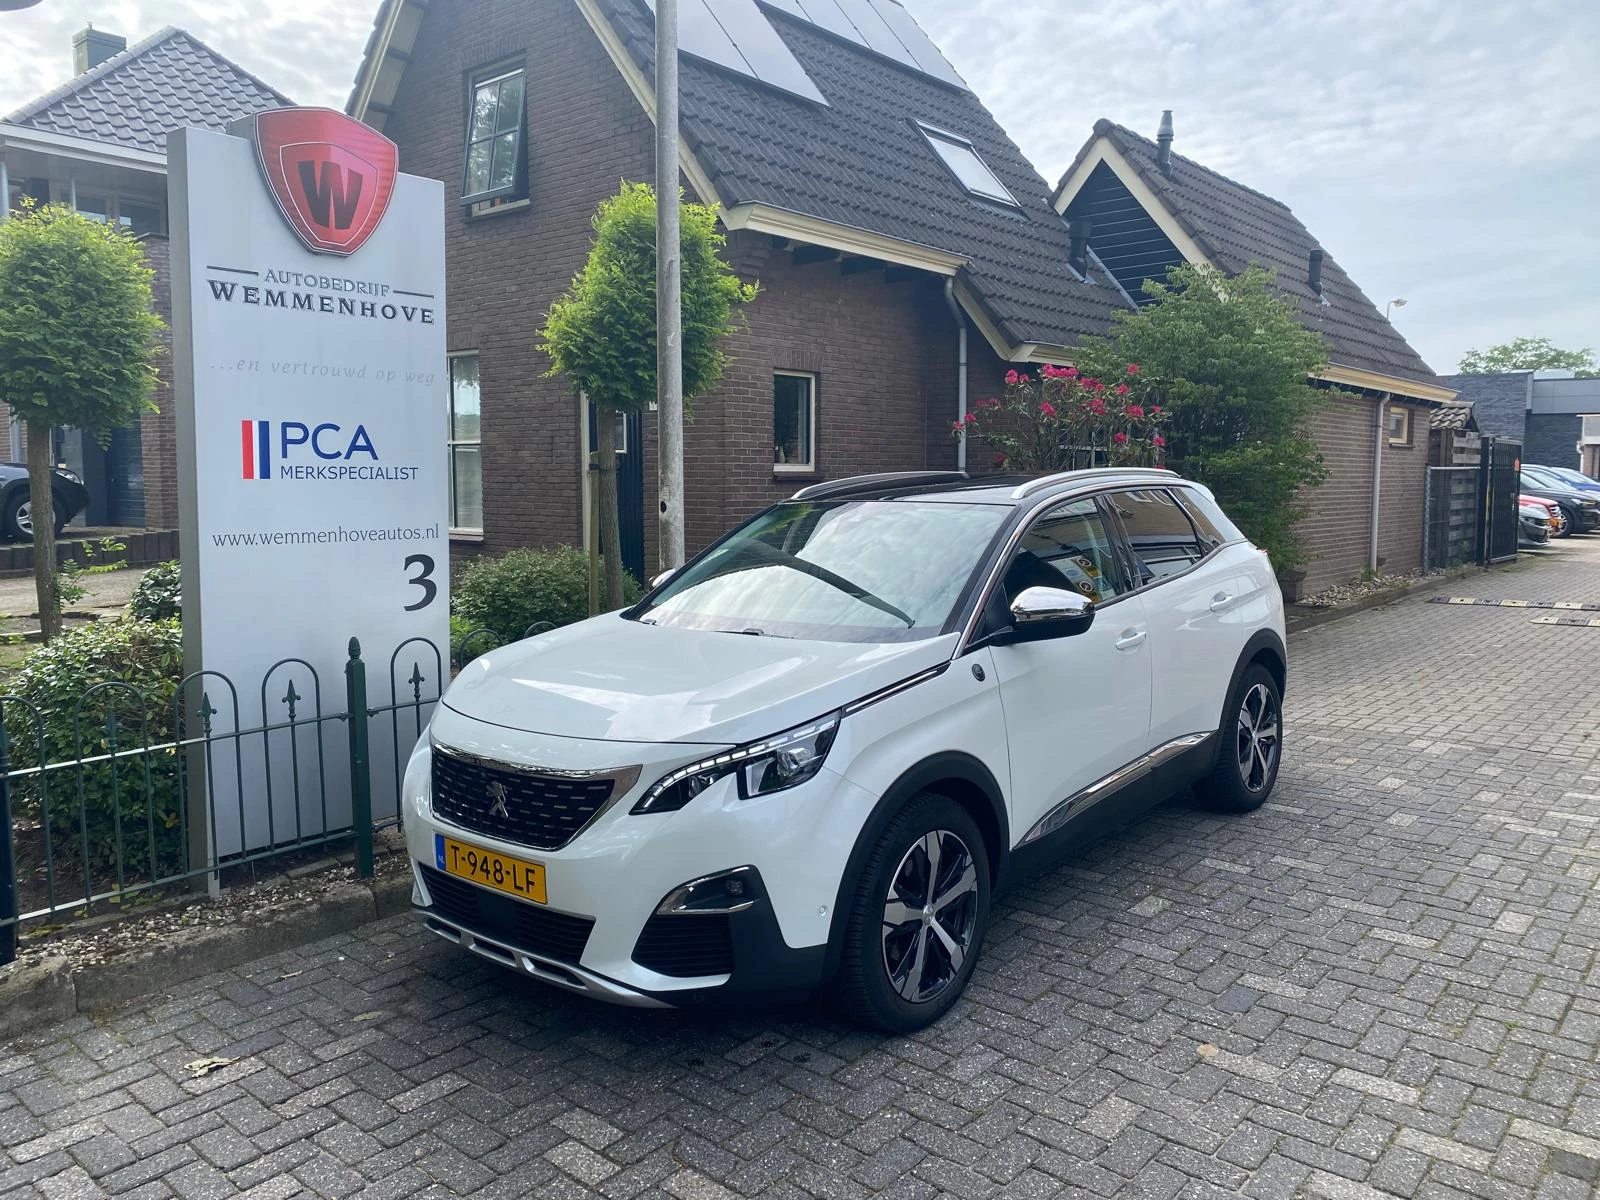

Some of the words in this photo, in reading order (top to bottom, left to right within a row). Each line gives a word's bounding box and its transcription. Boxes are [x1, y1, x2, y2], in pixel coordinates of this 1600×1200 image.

[297, 160, 363, 230] W
[207, 279, 435, 325] WEMMENHOVE
[264, 268, 391, 297] AUTOBEDRIJF
[271, 359, 368, 379] vertrouwd
[375, 369, 396, 384] op
[405, 372, 435, 386] weg
[281, 421, 379, 460] PCA
[280, 465, 419, 480] MERKSPECIALIST
[212, 523, 440, 547] www.wemmenhoveautos.nl
[403, 553, 438, 612] 3
[450, 844, 536, 893] T-948-LF
